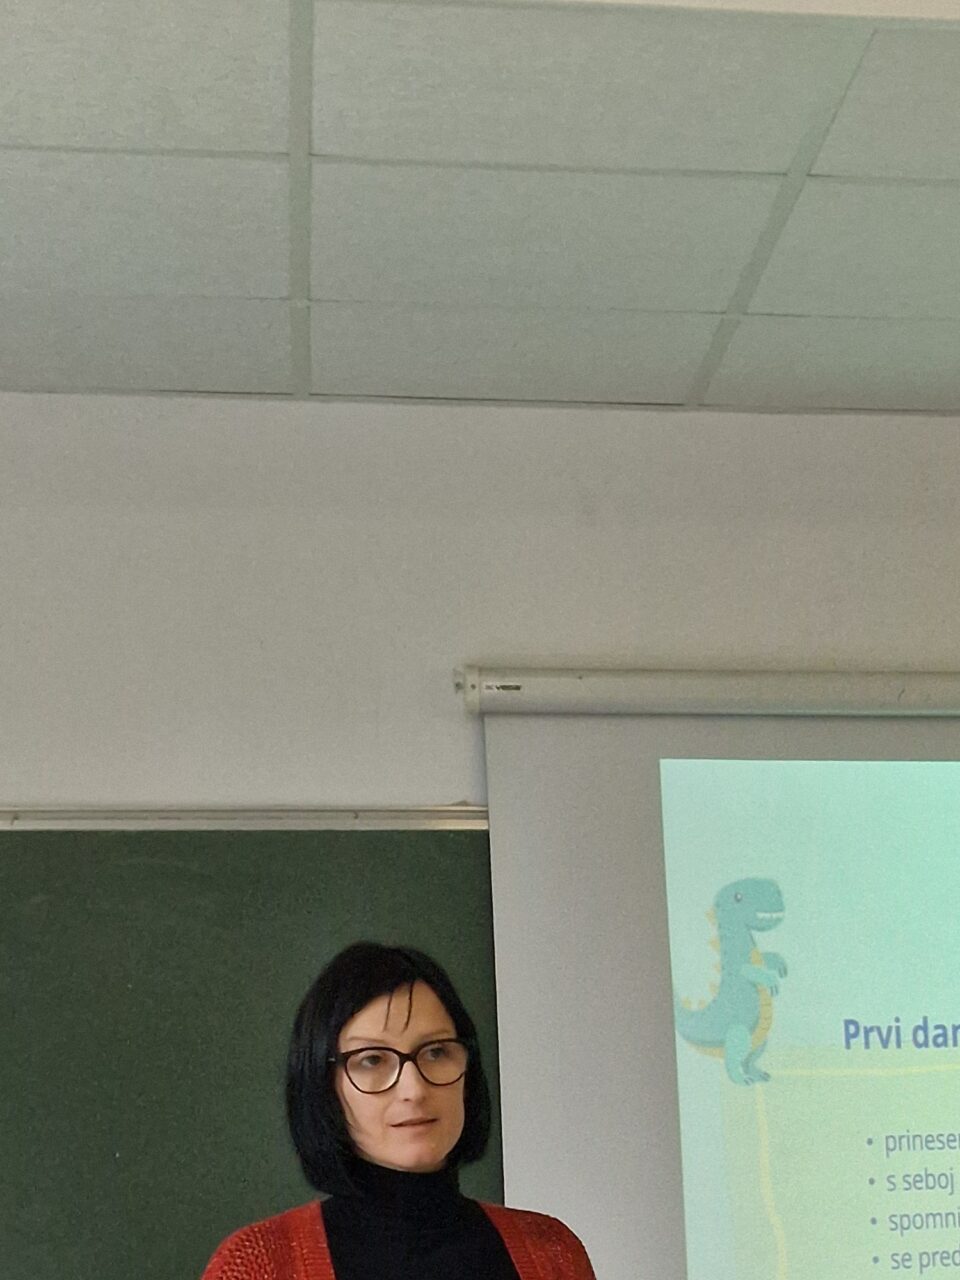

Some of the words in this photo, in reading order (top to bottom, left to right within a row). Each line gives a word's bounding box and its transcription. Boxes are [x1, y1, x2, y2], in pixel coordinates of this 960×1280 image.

[843, 1016, 901, 1050] Prvi
[886, 1173, 896, 1192] s
[902, 1166, 955, 1196] seboj
[891, 1251, 912, 1270] se
